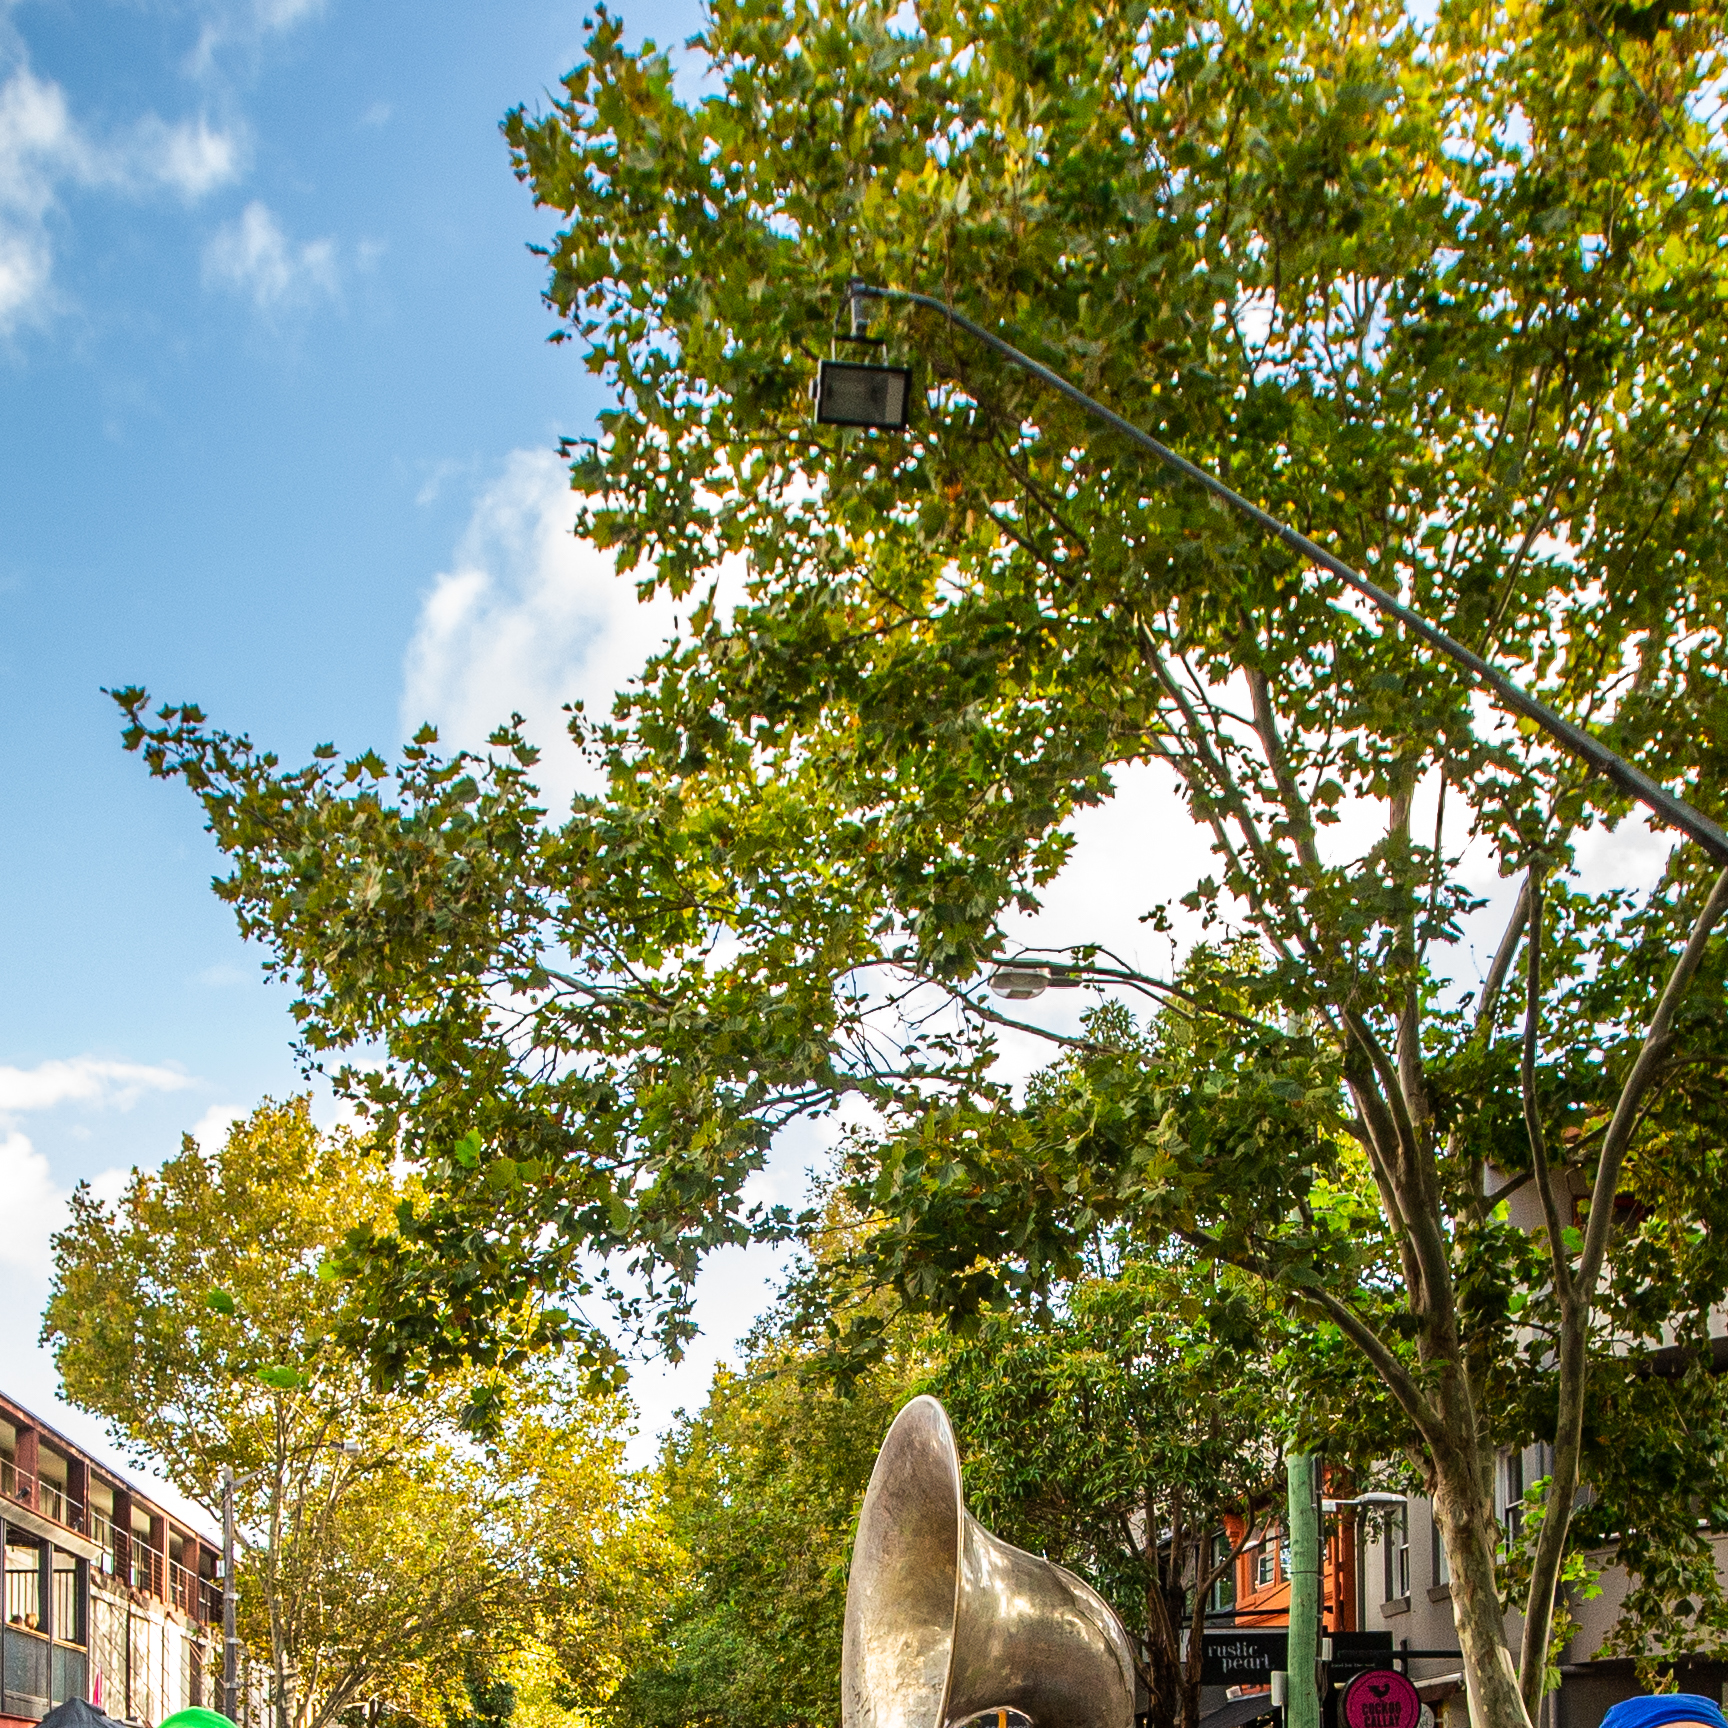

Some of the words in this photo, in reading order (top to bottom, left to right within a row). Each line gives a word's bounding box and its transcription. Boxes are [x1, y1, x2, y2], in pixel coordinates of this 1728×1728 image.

[1208, 1641, 1258, 1658] rustic
[1361, 1702, 1402, 1716] CUCKOO
[1363, 1714, 1400, 1728] CALLAY
